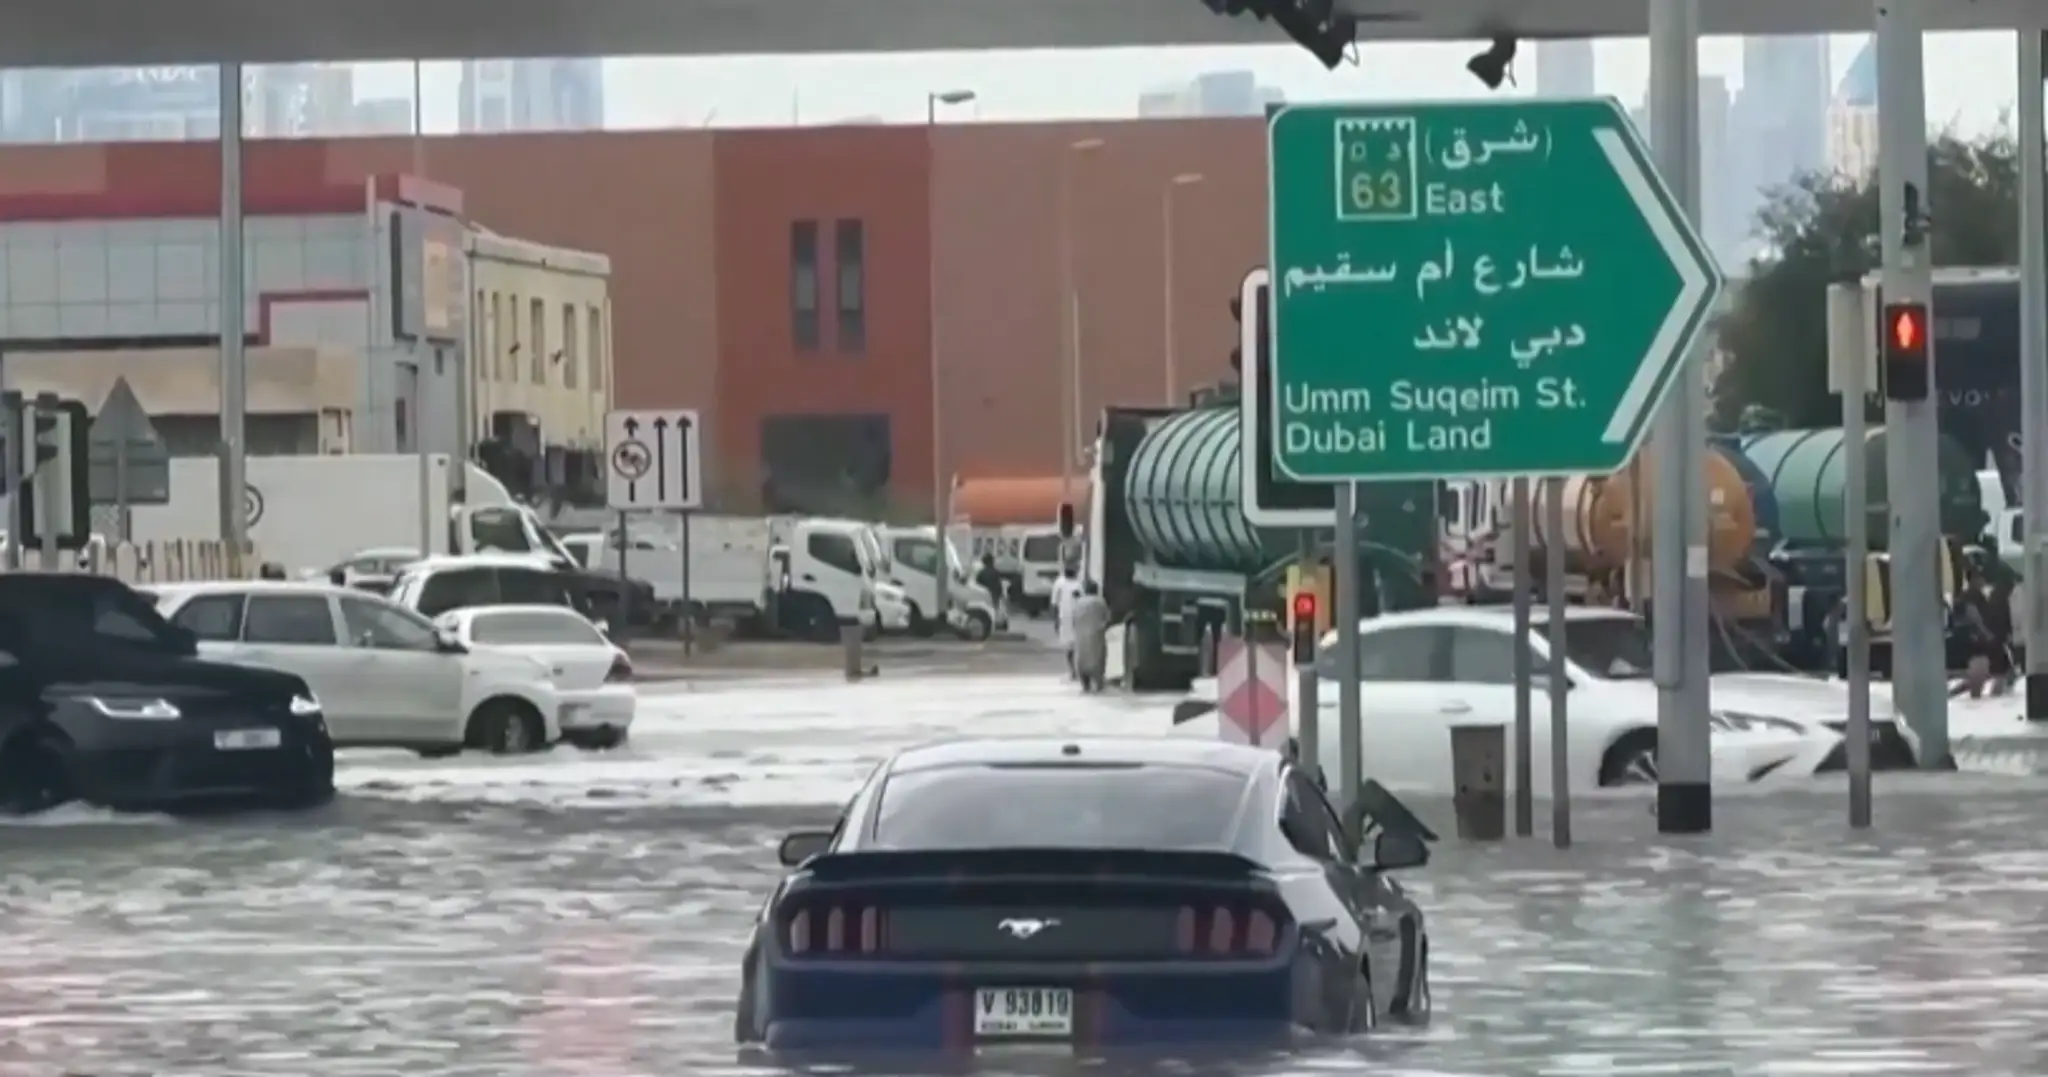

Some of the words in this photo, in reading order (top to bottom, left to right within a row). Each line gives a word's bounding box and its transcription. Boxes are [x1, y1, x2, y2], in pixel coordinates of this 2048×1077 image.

[1351, 169, 1402, 210] 63
[1425, 181, 1504, 214] East
[1283, 252, 1398, 298] سقيم
[1473, 245, 1584, 294] شارع
[1413, 314, 1484, 350] لاند
[1510, 322, 1587, 369] دبي
[1284, 383, 1371, 414] Umm
[1390, 378, 1520, 417] Suqeim
[1536, 377, 1587, 408] St.
[1285, 420, 1386, 454] Dubai
[1407, 418, 1491, 451] Land
[983, 991, 996, 1015] V
